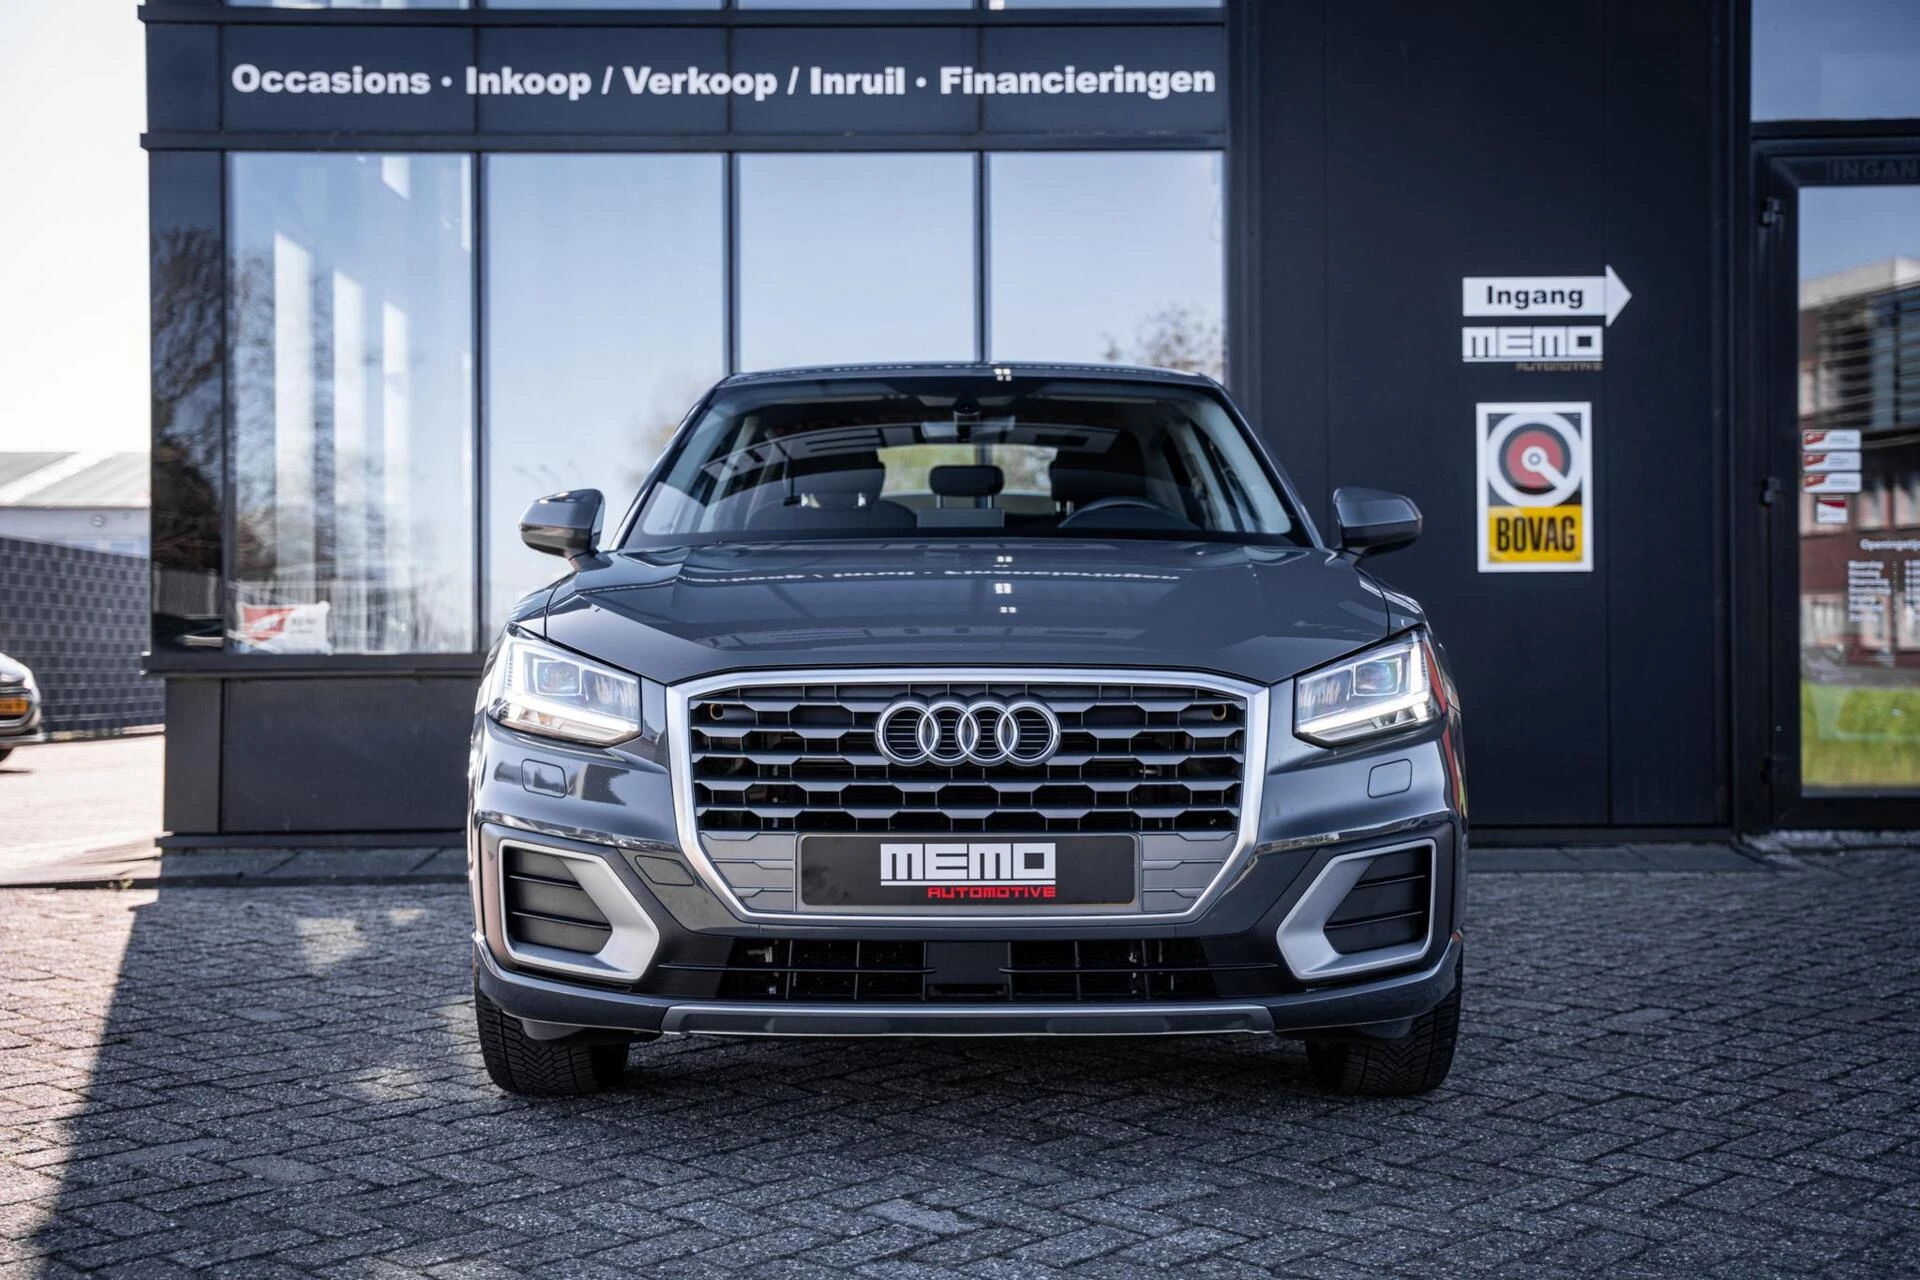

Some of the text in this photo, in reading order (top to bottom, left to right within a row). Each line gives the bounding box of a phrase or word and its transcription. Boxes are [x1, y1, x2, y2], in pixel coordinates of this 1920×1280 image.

[231, 63, 431, 95] Occasions
[465, 66, 592, 101] Inkoop
[622, 66, 778, 102] Verkoop
[810, 66, 906, 96] Inruil
[940, 64, 1216, 100] Financieringen
[1486, 285, 1584, 310] Ingang
[1462, 327, 1603, 359] MEMO
[1496, 516, 1576, 553] BOVAG
[880, 842, 1056, 880] MEMO
[927, 885, 1057, 899] AUTOMOTIVE
